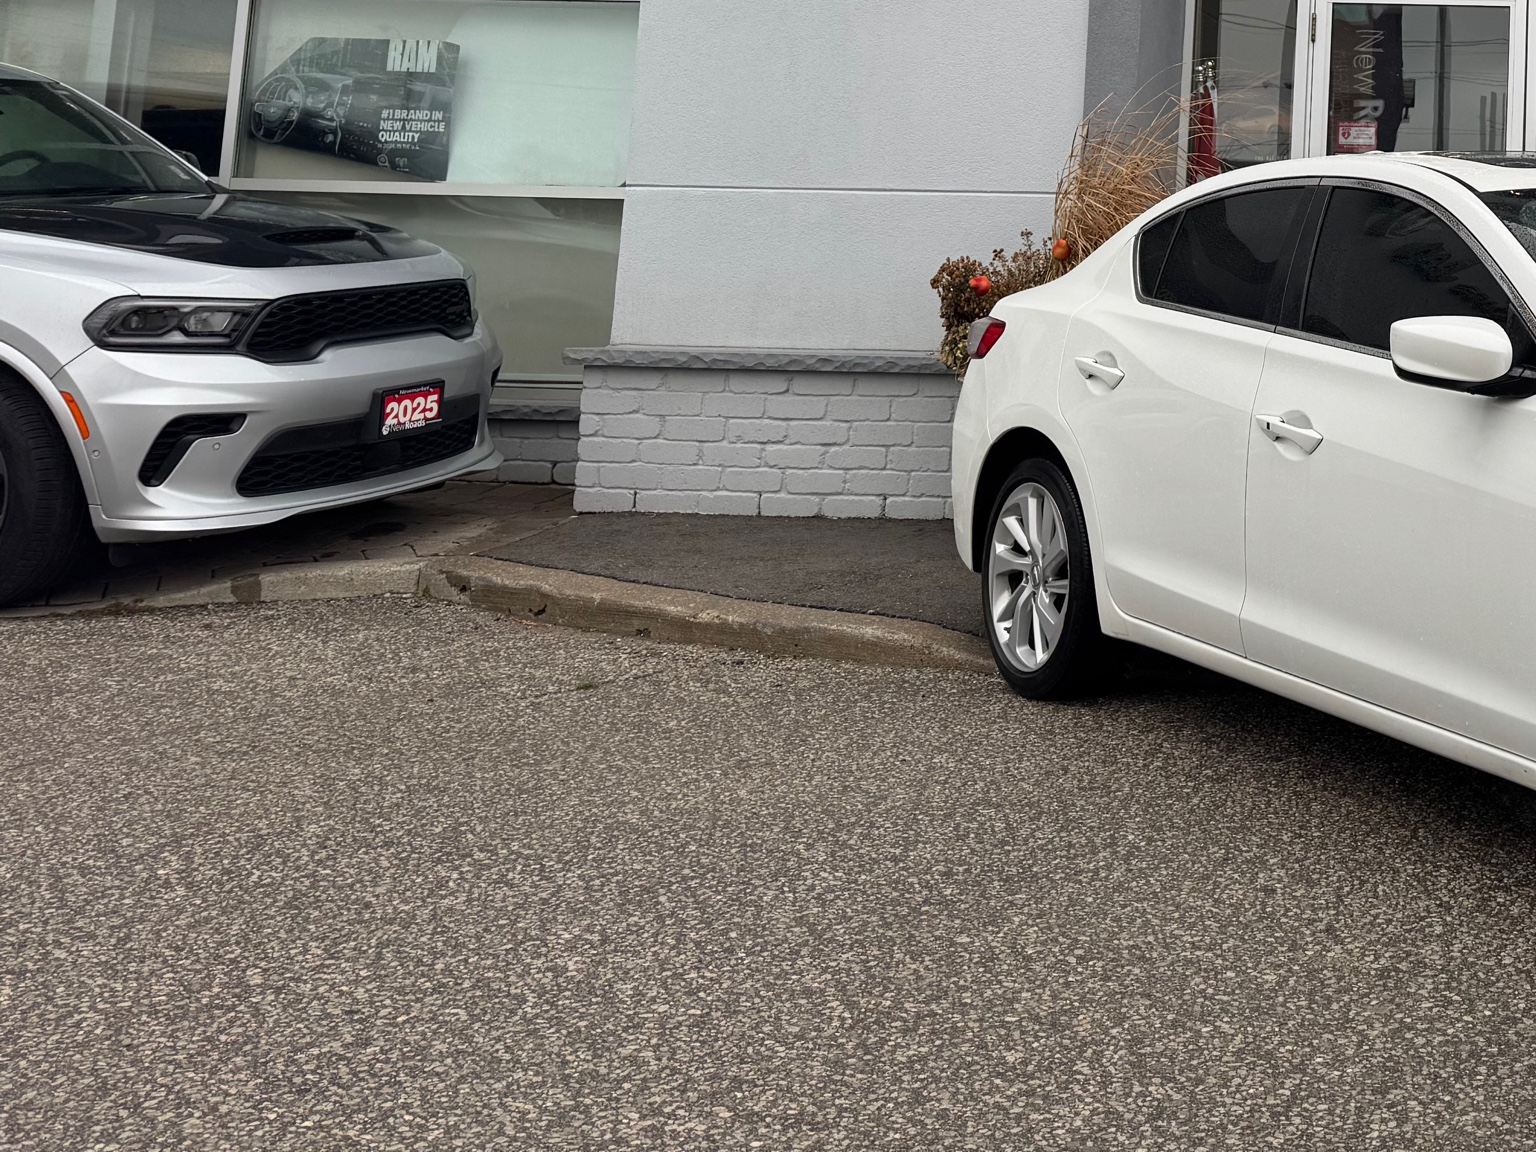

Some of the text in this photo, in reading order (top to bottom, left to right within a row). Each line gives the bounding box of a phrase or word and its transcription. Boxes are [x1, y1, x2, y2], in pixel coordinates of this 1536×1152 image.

[386, 39, 438, 73] RAM
[381, 108, 443, 121] #1 BRAND IN
[379, 120, 446, 132] NEW VEHICLE
[378, 131, 420, 142] QUALITY
[386, 395, 438, 425] 2025
